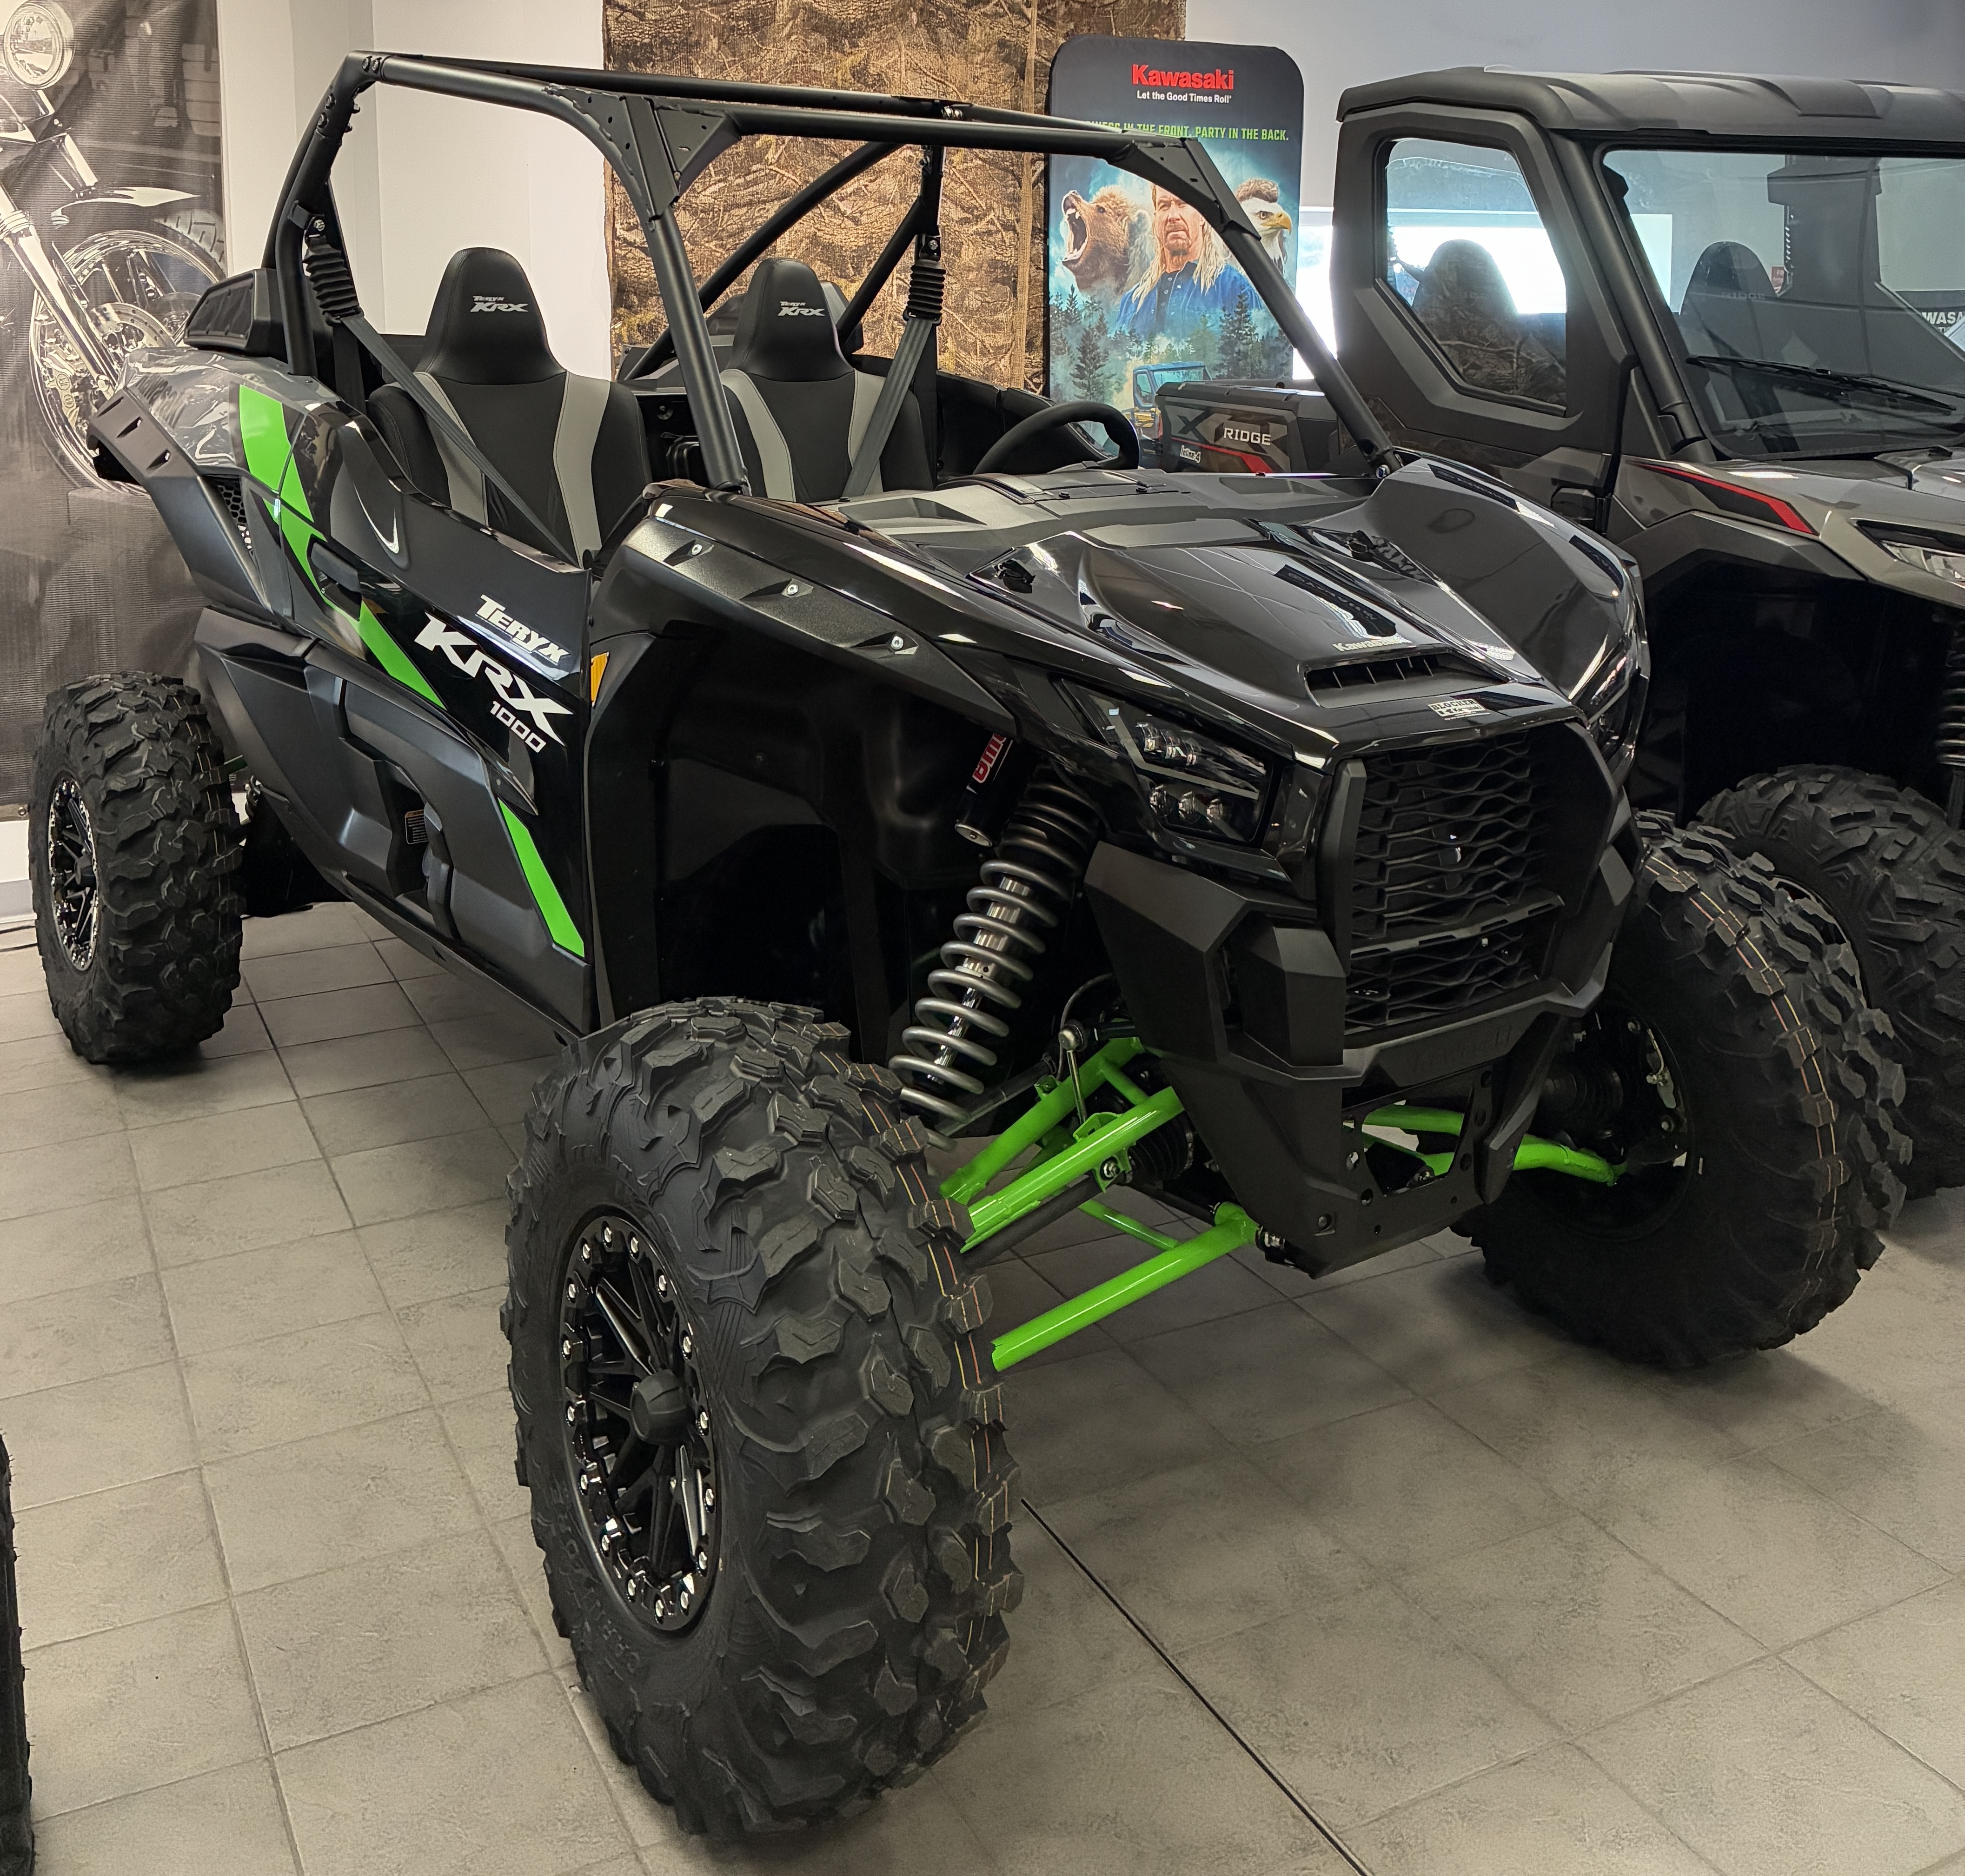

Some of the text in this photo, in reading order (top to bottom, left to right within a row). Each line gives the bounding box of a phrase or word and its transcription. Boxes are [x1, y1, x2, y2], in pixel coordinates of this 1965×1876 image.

[1132, 64, 1234, 90] Kawasaki
[1137, 90, 1150, 99] Let
[1152, 91, 1165, 100] the
[1166, 92, 1188, 101] Good
[1189, 93, 1213, 103] Times
[1136, 124, 1155, 132] THE
[1195, 126, 1226, 139] PARTY
[1228, 127, 1239, 139] IN
[1241, 128, 1259, 139] THE
[1261, 129, 1289, 141] BACK.
[470, 302, 529, 312] KRX
[777, 307, 826, 316] KRX
[1223, 427, 1271, 446] RIDGE
[414, 611, 575, 747] KRX
[490, 700, 547, 753] 1000
